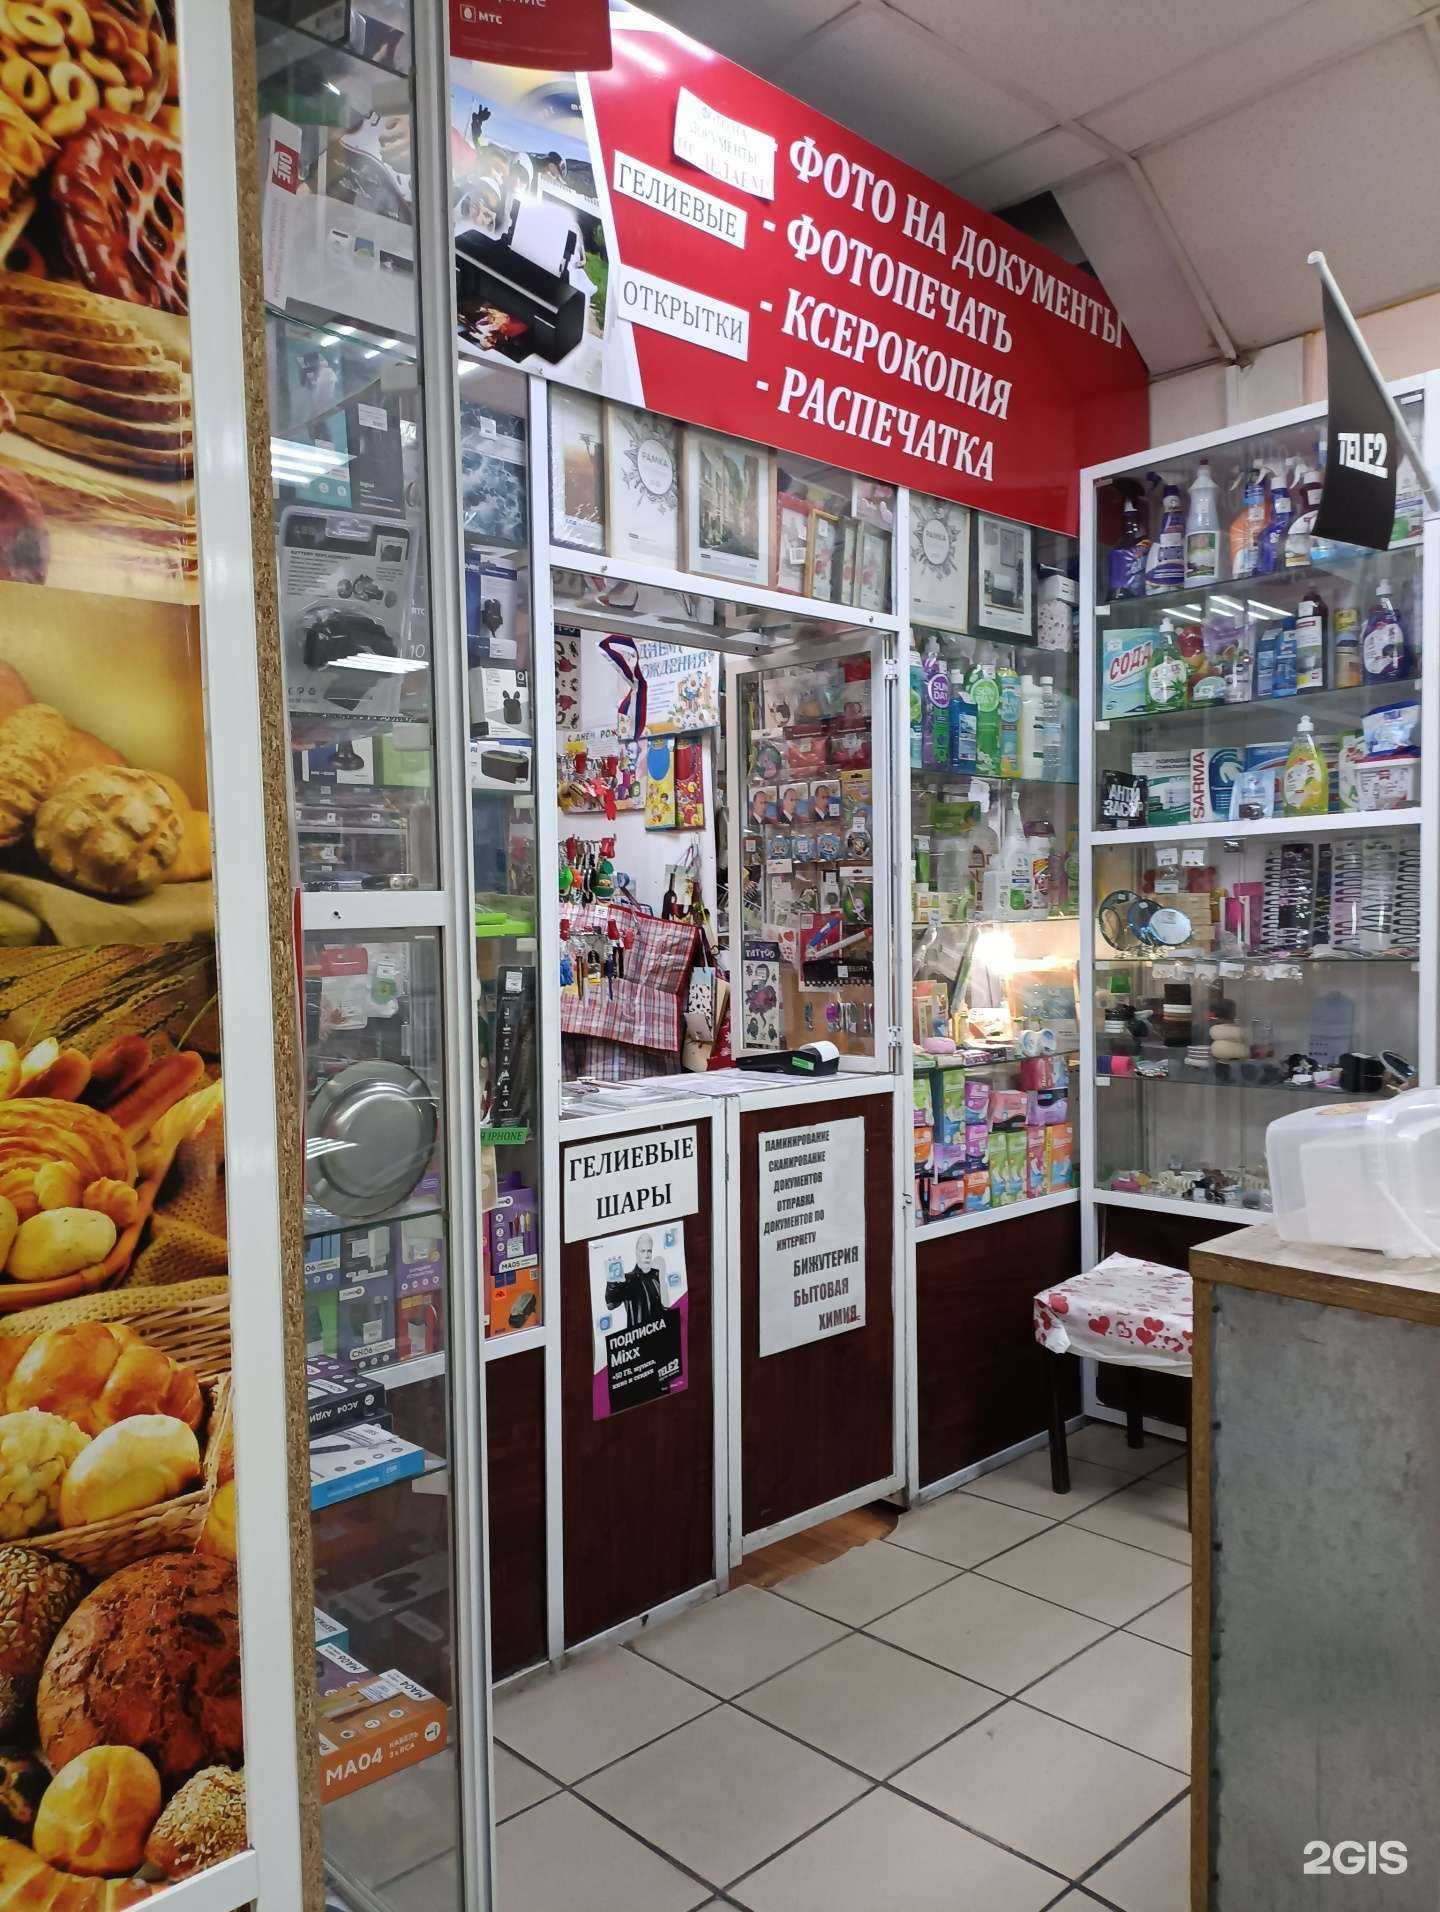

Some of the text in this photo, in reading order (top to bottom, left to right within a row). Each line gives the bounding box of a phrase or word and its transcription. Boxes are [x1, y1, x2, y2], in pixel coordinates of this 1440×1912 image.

[618, 162, 738, 239] ГЕЛИЕВЫЕ
[789, 136, 1123, 350] ФОТО НА ДОКУМЕНТЫ
[787, 214, 1012, 354] ФОТОПЕЧАТЬ
[623, 280, 743, 344] ОТКРЫТКИ
[781, 288, 1013, 421] КСЕРОКОПИЯ
[777, 367, 995, 483] РАСПЕЧАТКА
[1337, 432, 1388, 479] TELE2
[1109, 642, 1153, 680] СОДА
[1193, 751, 1206, 819] SARMA
[487, 1130, 523, 1142] IPHONE
[569, 1137, 694, 1182] ГЕЛИЕВЫЕ
[596, 1183, 671, 1220] ШАРЫ
[773, 1172, 823, 1194] ДОКУМЕНТОВ
[763, 1212, 813, 1236] ДОКУМЕНТОВ
[776, 1231, 817, 1252] ИНТЕРНЕТУ
[793, 1245, 859, 1277] БИЖУТЕРИЯ
[793, 1277, 849, 1308] БЫТОВАЯ
[609, 1318, 667, 1350] ПОДПИСКА
[818, 1304, 858, 1331] ХИМИЯ
[610, 1347, 641, 1368] Mixx
[657, 1358, 680, 1378] TELE2
[326, 1746, 384, 1786] MA04
